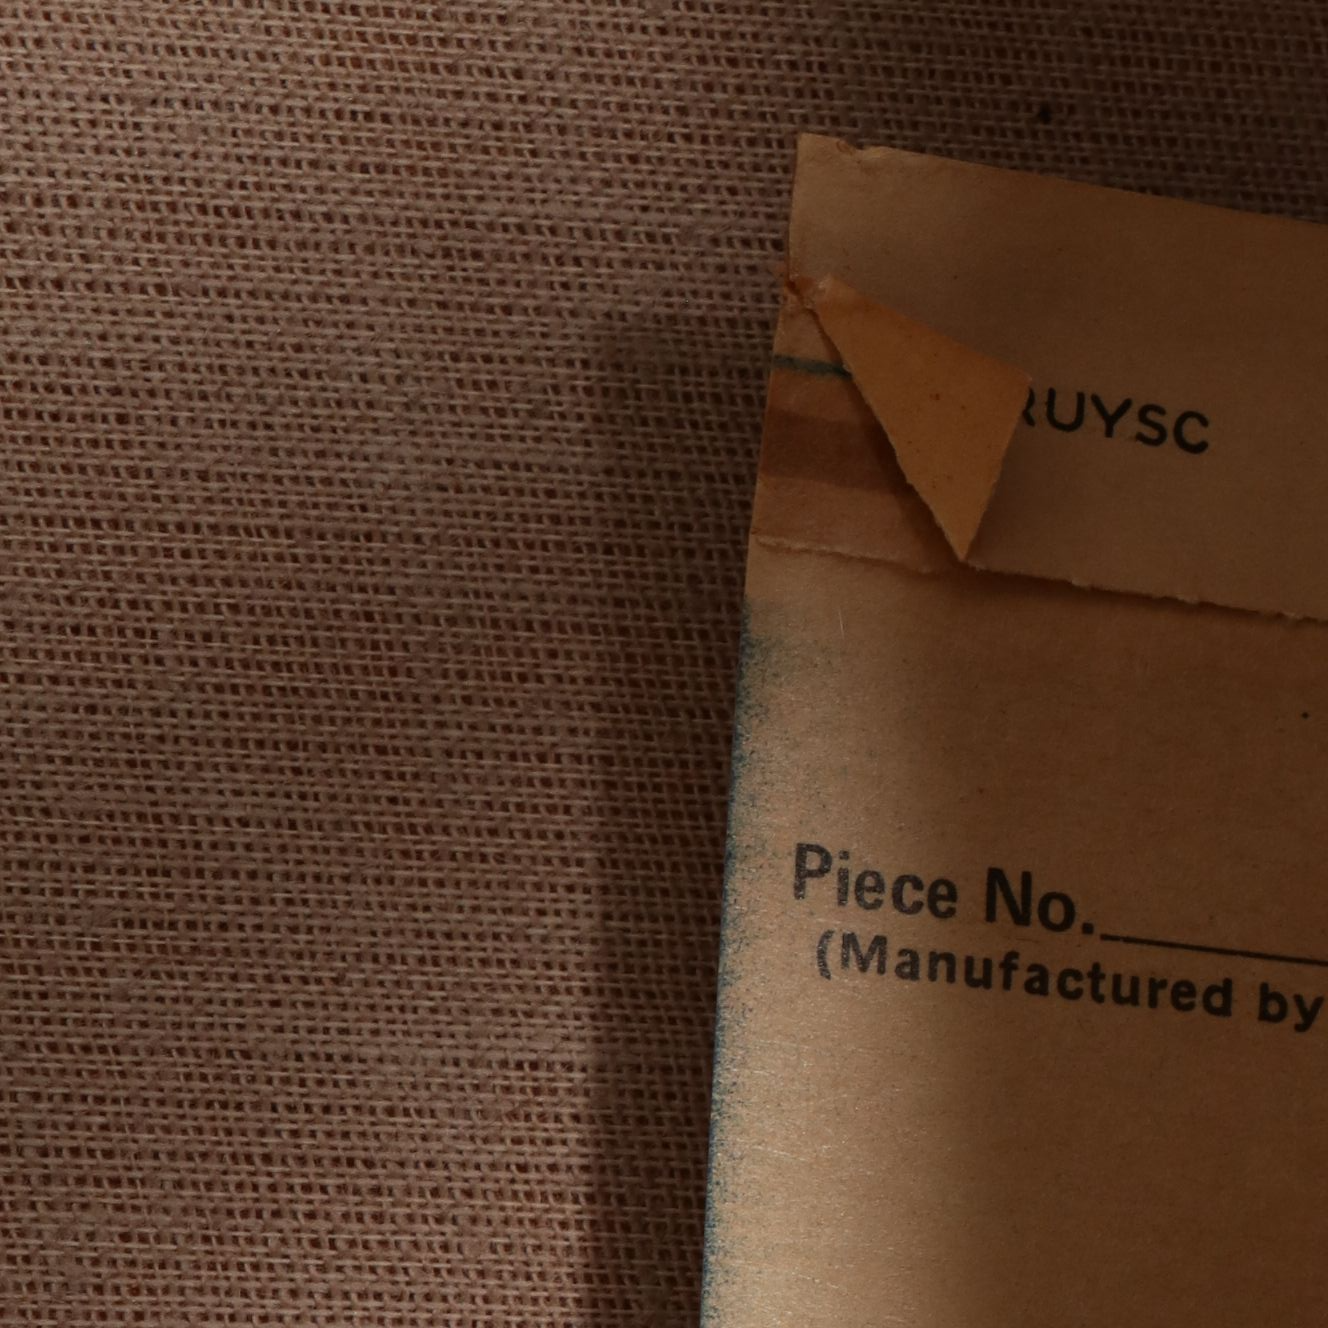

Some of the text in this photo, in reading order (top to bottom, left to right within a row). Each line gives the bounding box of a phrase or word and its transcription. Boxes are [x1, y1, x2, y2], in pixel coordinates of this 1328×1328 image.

[794, 842, 1094, 935] Piece No.
[816, 930, 1233, 1018] (Manufactured
[1258, 982, 1324, 1033] by
